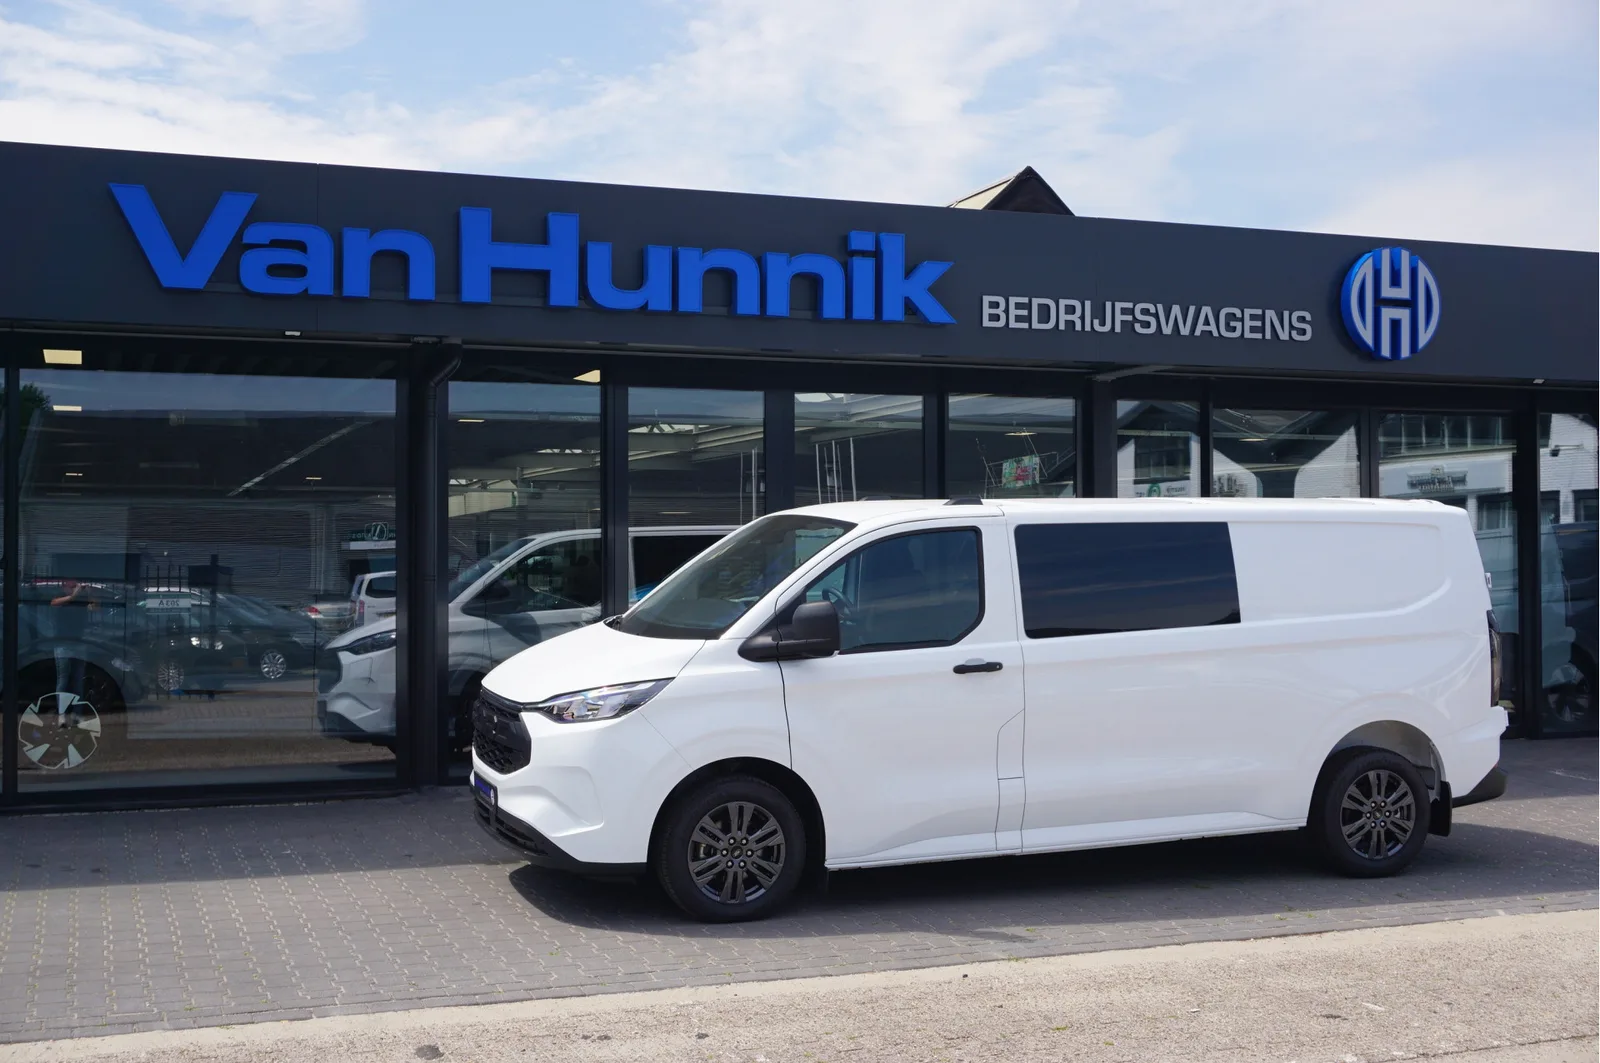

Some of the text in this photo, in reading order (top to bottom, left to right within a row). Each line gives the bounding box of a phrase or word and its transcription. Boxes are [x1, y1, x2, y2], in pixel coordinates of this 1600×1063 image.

[108, 182, 957, 326] Van Hunnik
[980, 293, 1313, 342] BEDRIJFSWAGENS
